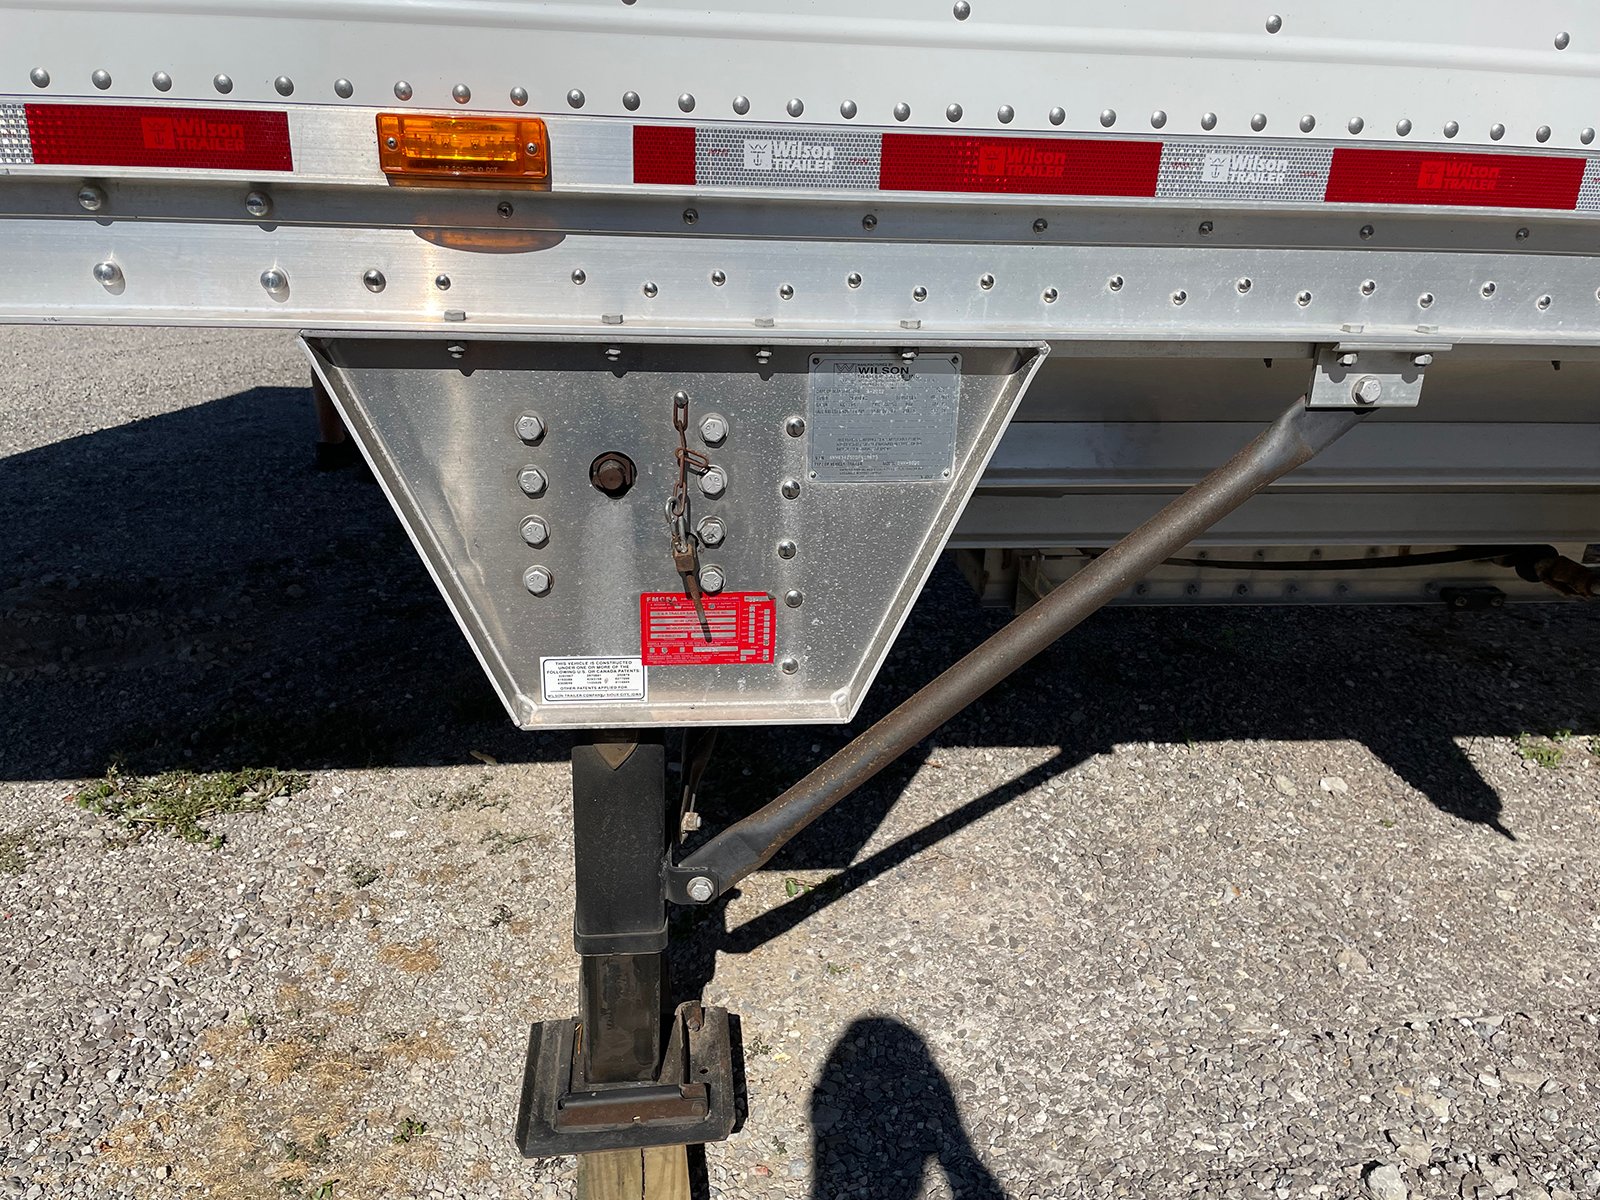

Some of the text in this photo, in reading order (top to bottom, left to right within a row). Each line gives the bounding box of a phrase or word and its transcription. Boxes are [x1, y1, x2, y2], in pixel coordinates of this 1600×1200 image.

[173, 117, 244, 137] Wilson
[176, 137, 245, 151] TRAILER
[772, 140, 834, 159] Wilson
[1006, 147, 1066, 165] Wilson
[1231, 154, 1289, 172] Wilson
[773, 159, 833, 172] TRAILER
[1006, 164, 1064, 177] TRAILER
[1446, 161, 1500, 178] Wilson
[1229, 171, 1285, 184] TRAILER
[1444, 178, 1497, 190] TRAILER
[858, 366, 909, 375] WILSON
